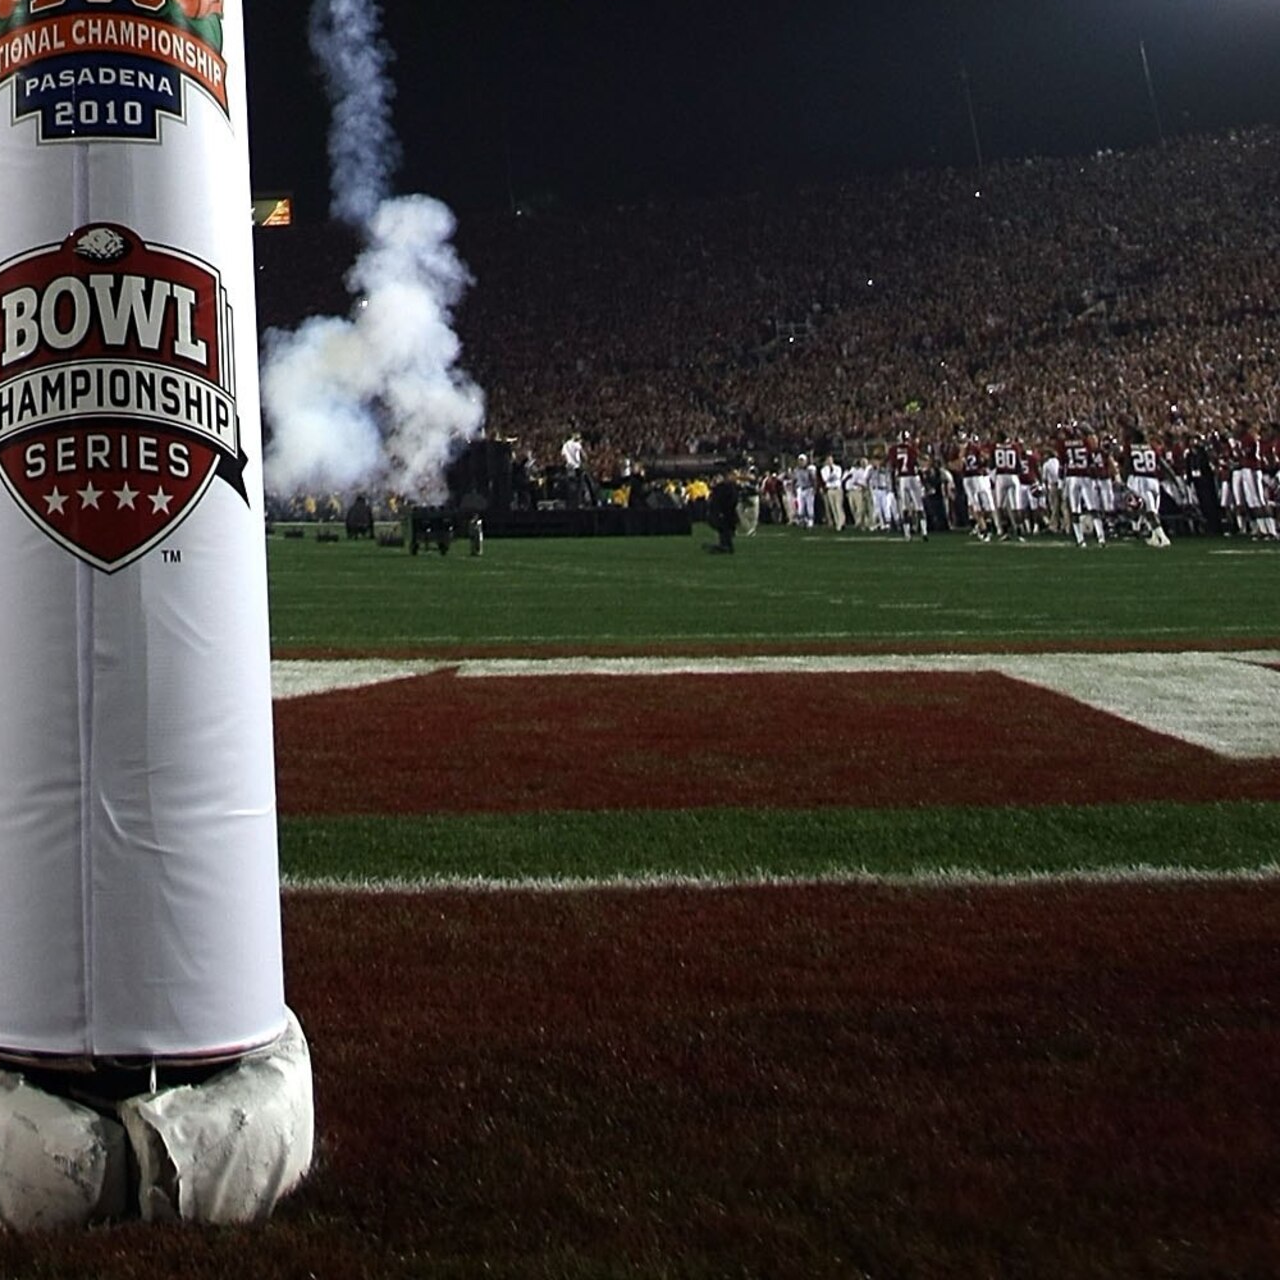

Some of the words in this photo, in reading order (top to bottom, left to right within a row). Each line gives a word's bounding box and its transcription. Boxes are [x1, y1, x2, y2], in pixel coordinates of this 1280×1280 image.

[72, 19, 223, 88] CHAMPIONSHIP
[25, 68, 174, 97] PASADENA
[55, 101, 143, 126] 2010
[2, 274, 208, 366] BOWL
[25, 434, 189, 478] SERIES
[896, 454, 908, 472] 7
[995, 449, 1017, 469] 80
[1066, 448, 1087, 469] 15
[1131, 450, 1156, 472] 28
[161, 550, 181, 563] TM
